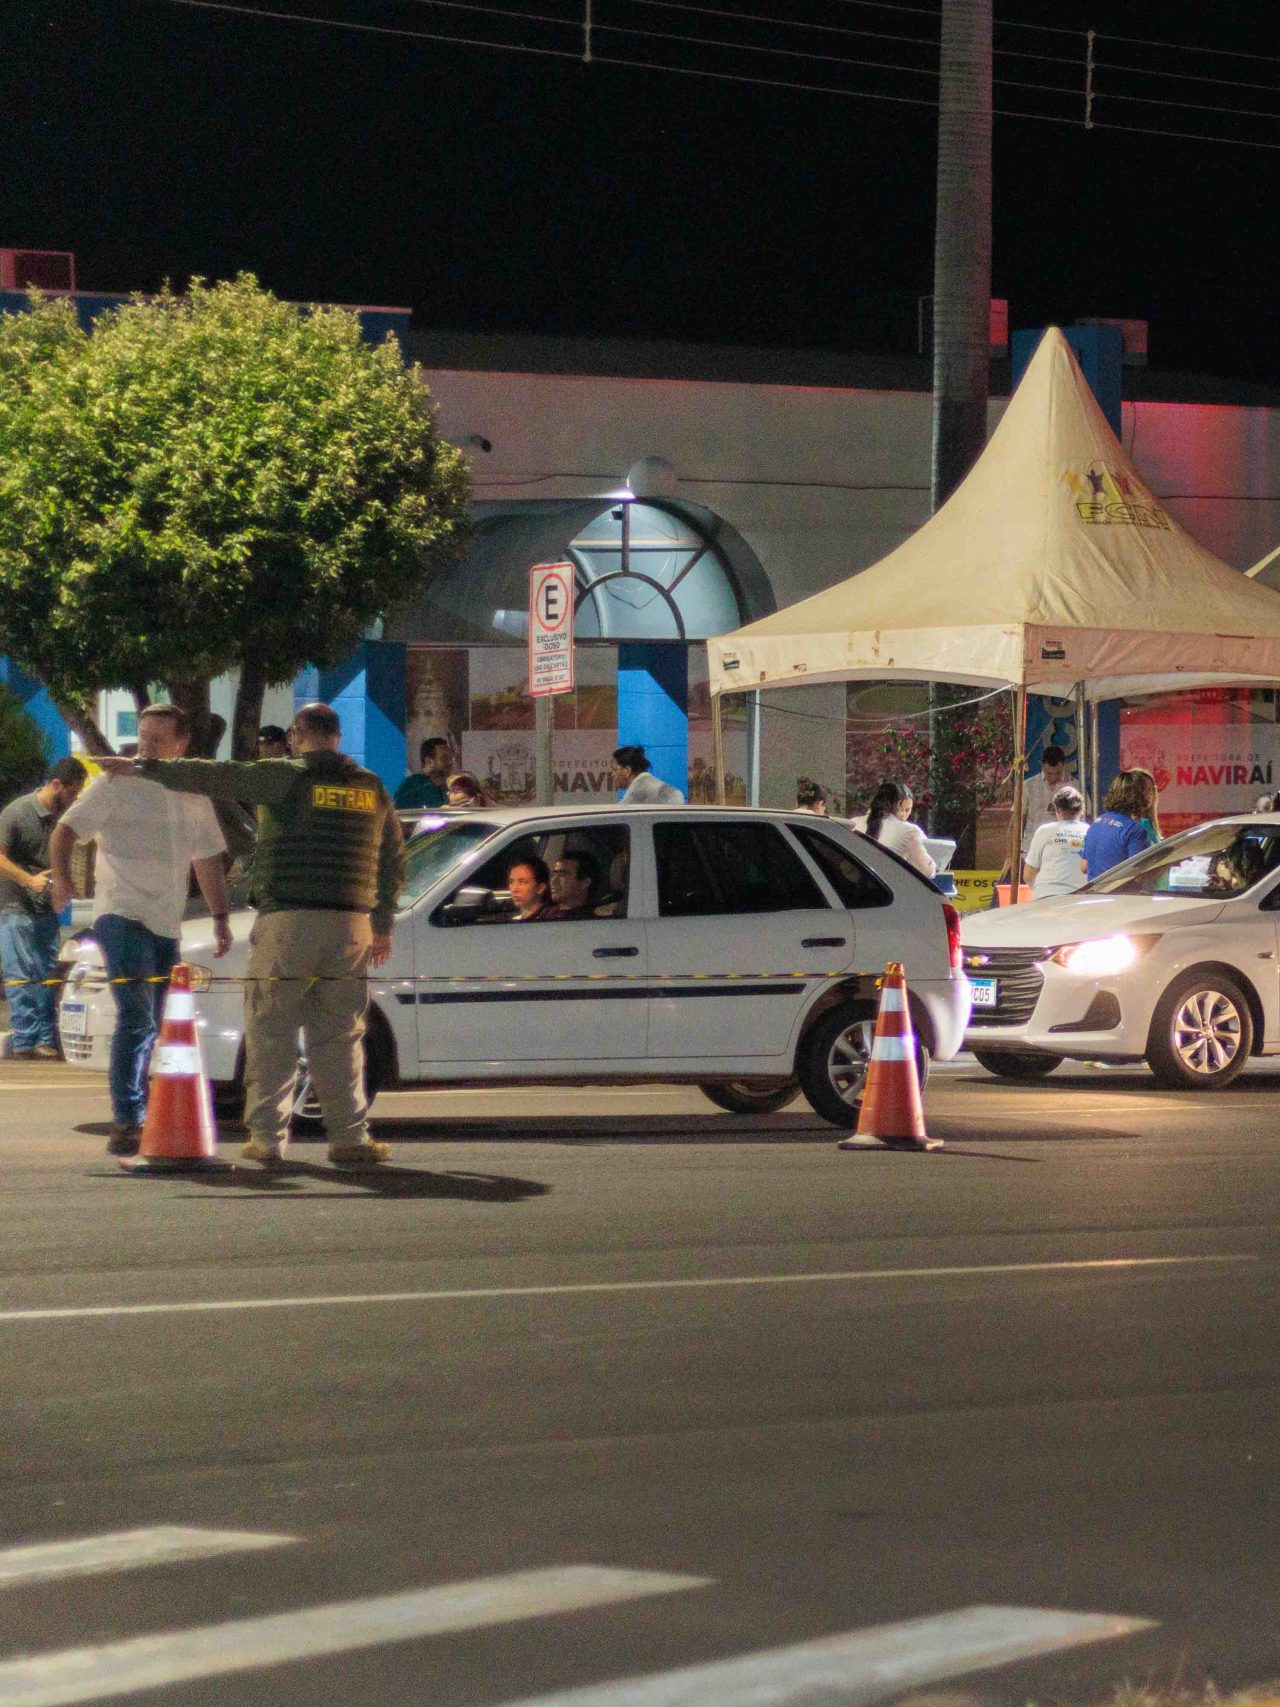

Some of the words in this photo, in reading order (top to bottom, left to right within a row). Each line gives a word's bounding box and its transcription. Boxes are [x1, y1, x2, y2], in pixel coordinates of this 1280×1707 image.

[1076, 503, 1169, 525] FCN
[545, 585, 558, 620] E
[536, 632, 567, 643] EXCLUSIVO
[543, 642, 561, 650] IDOSO
[550, 760, 608, 768] PREFEITU
[1176, 760, 1273, 785] NAVIRAÍ
[553, 771, 614, 792] NAVI
[314, 787, 377, 810] DETRAN
[971, 987, 990, 1001] C05
